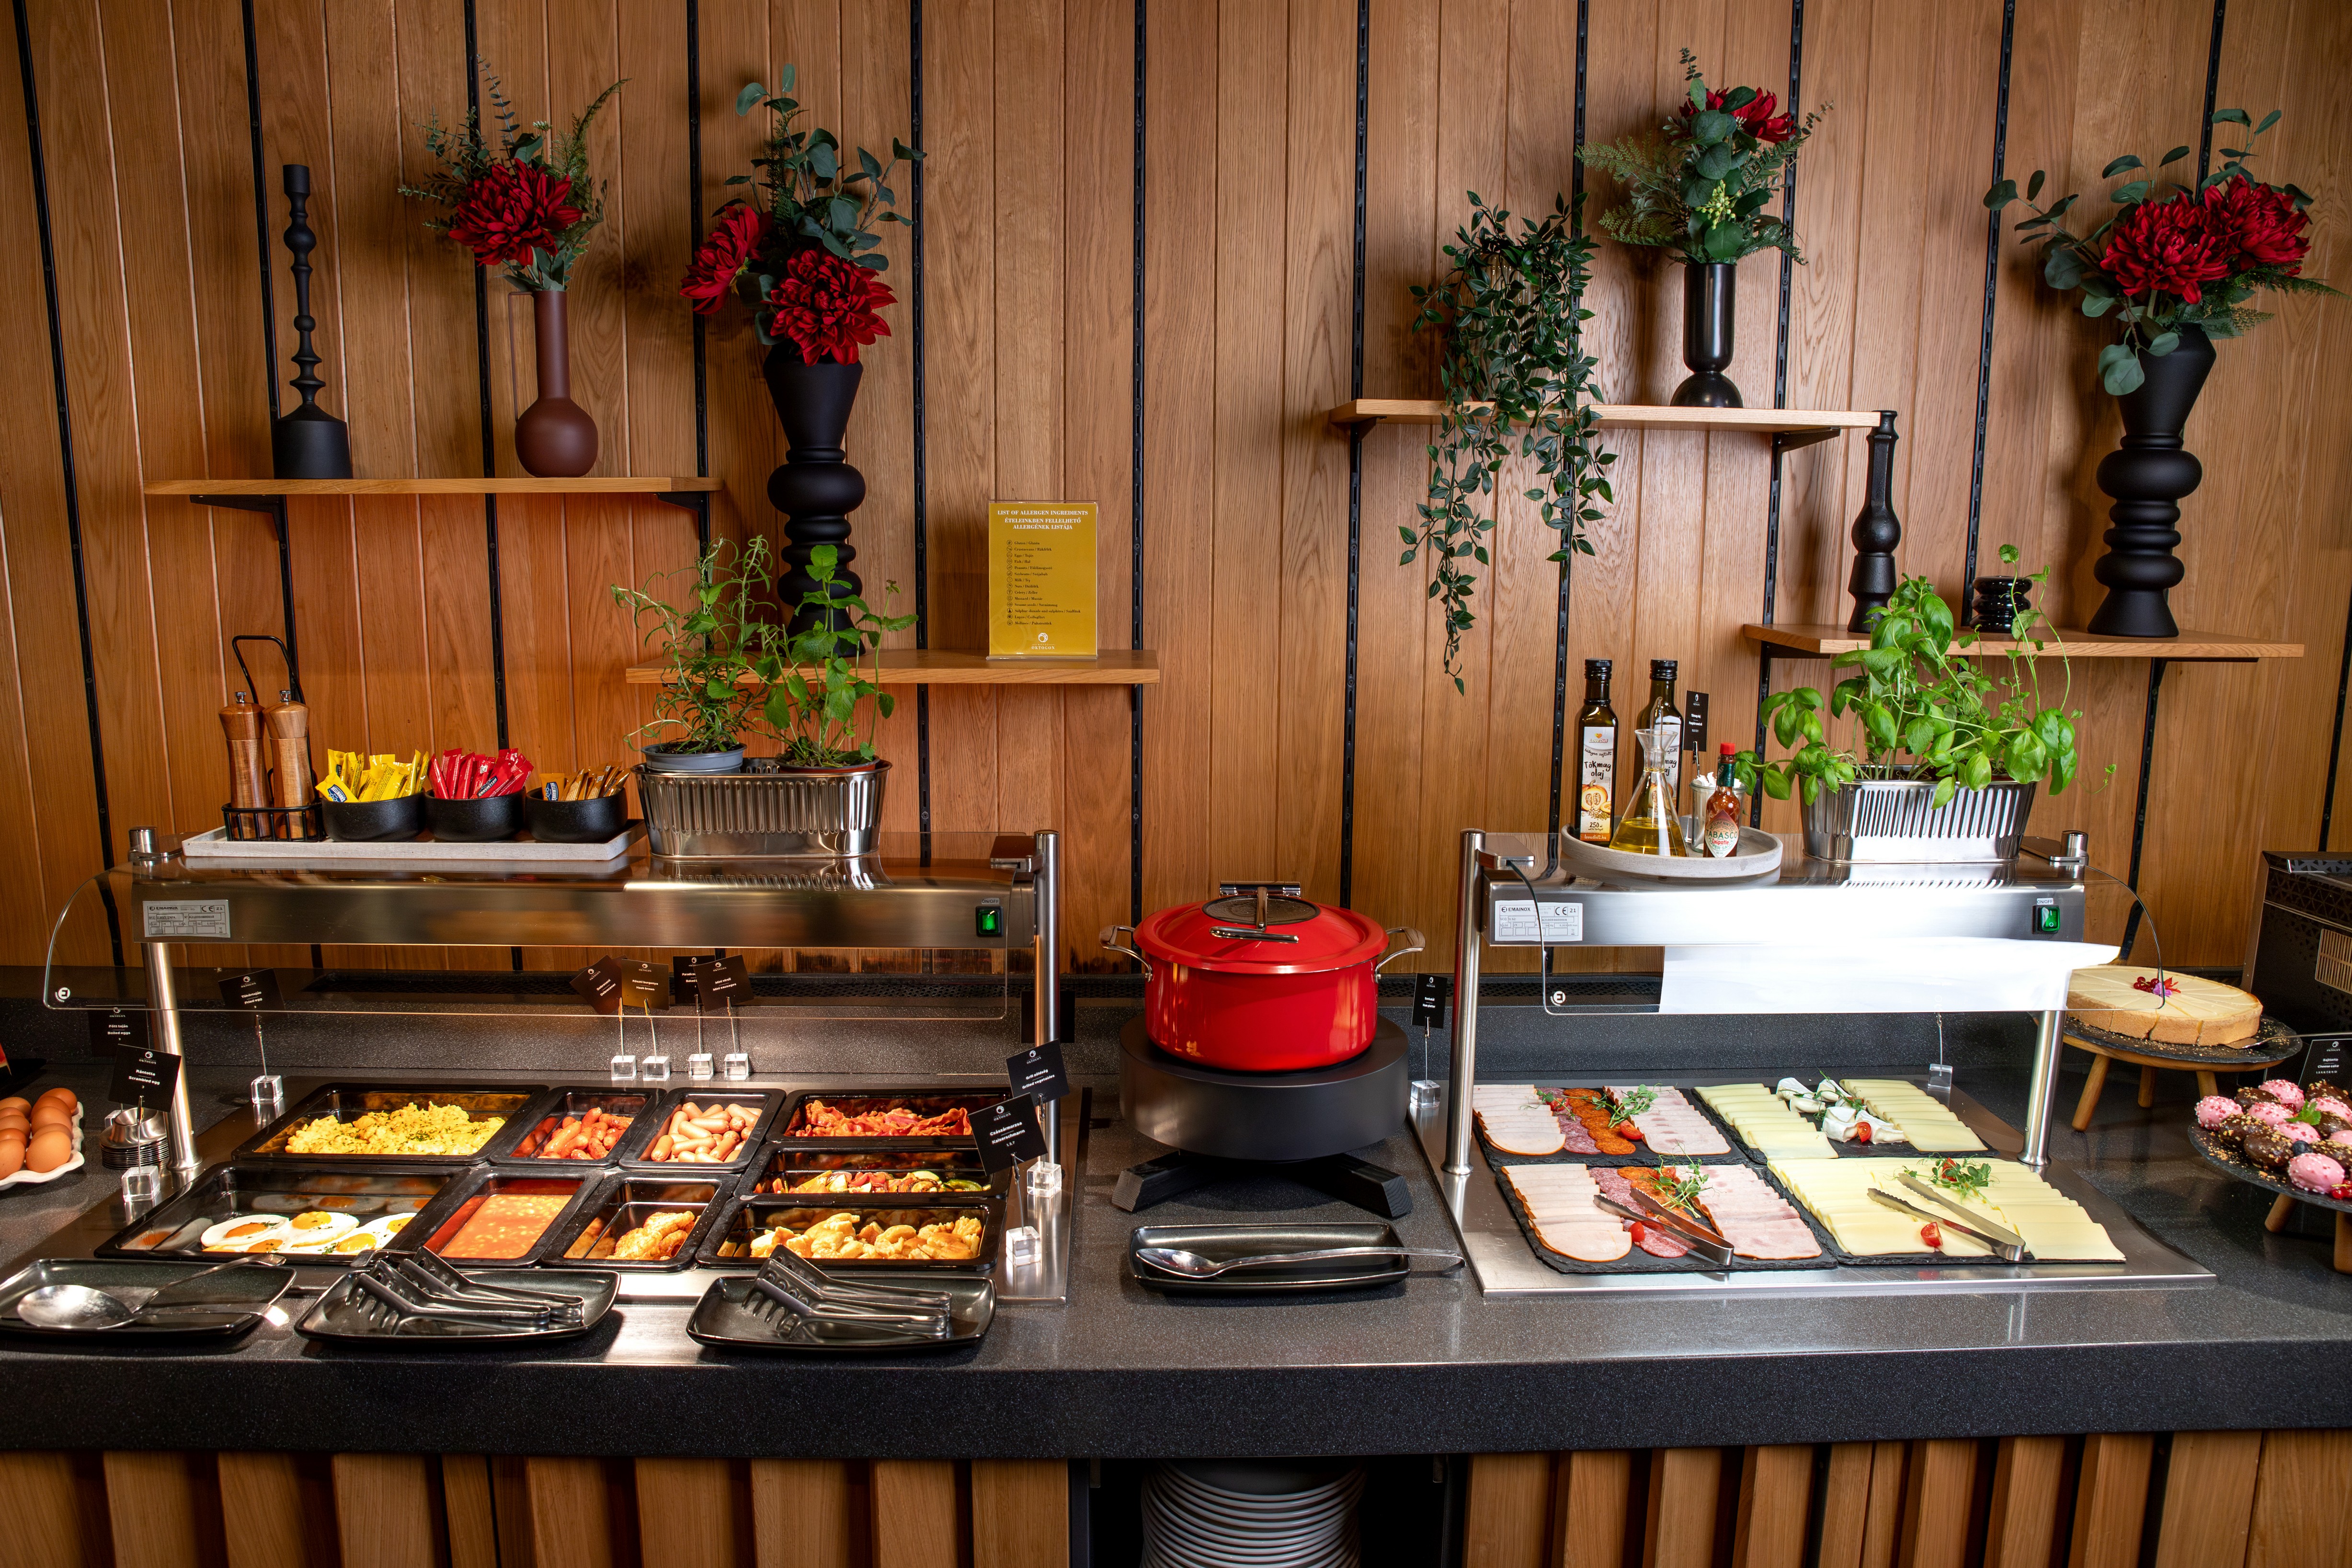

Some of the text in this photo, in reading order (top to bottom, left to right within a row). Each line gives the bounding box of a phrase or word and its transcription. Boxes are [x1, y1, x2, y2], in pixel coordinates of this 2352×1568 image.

[1591, 767, 1604, 779] olaj
[330, 786, 345, 802] HELLMANN'S
[1706, 829, 1737, 839] TABASCO
[1034, 1074, 1055, 1085] vegetables
[993, 1112, 1012, 1121] OKTOGON
[990, 1122, 1023, 1136] Császármorzsa
[992, 1129, 1026, 1145] Kaiserschmarrn
